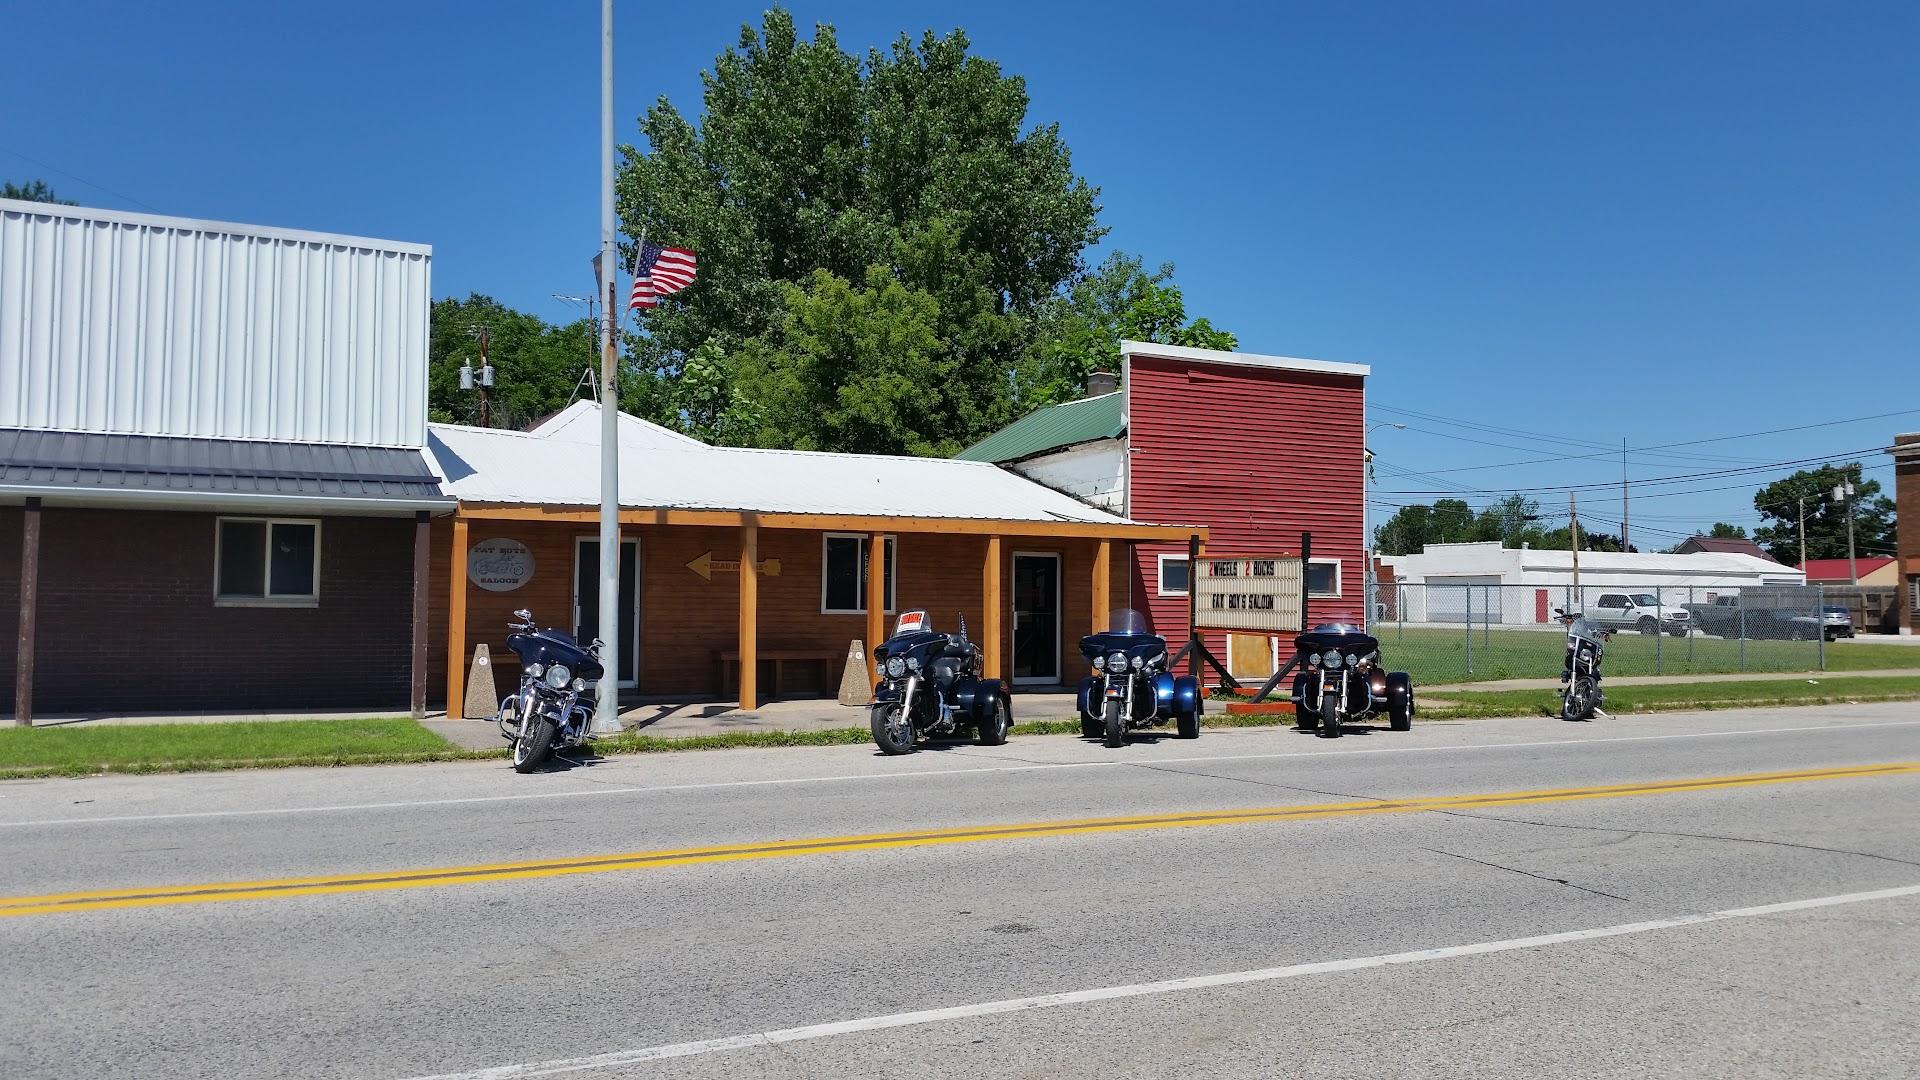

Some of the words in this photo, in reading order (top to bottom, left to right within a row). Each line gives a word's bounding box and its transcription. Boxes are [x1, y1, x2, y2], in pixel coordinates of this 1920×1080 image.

[1254, 560, 1274, 575] BUCKS
[1212, 593, 1224, 608] FAT
[1249, 594, 1273, 609] SALOON
